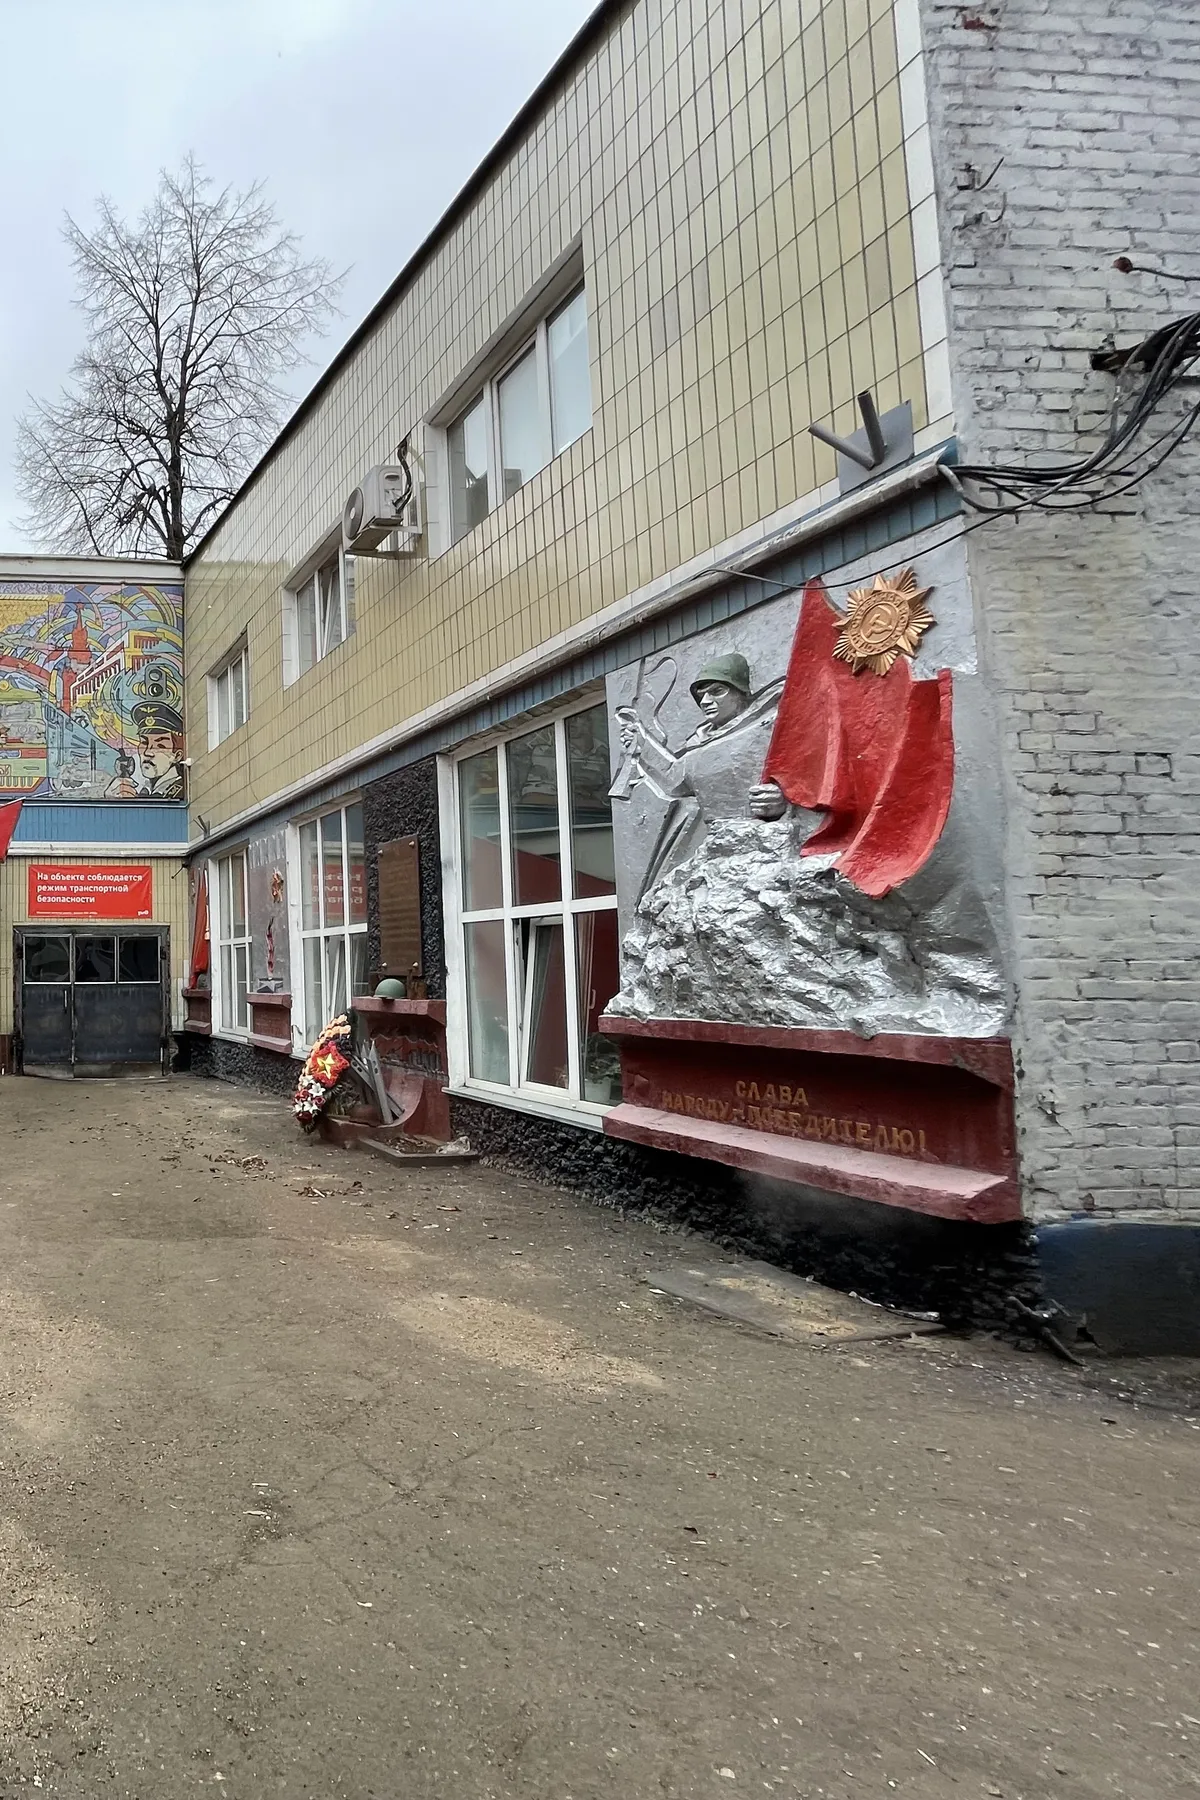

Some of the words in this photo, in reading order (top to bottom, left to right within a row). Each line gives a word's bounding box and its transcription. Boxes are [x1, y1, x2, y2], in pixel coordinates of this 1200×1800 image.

[37, 872, 48, 881] На
[51, 872, 85, 881] объекте
[87, 873, 143, 882] соблюдается
[37, 885, 67, 893] режим
[70, 883, 129, 893] транспортной
[37, 894, 95, 903] безопасности
[735, 1080, 809, 1107] СЛАВА
